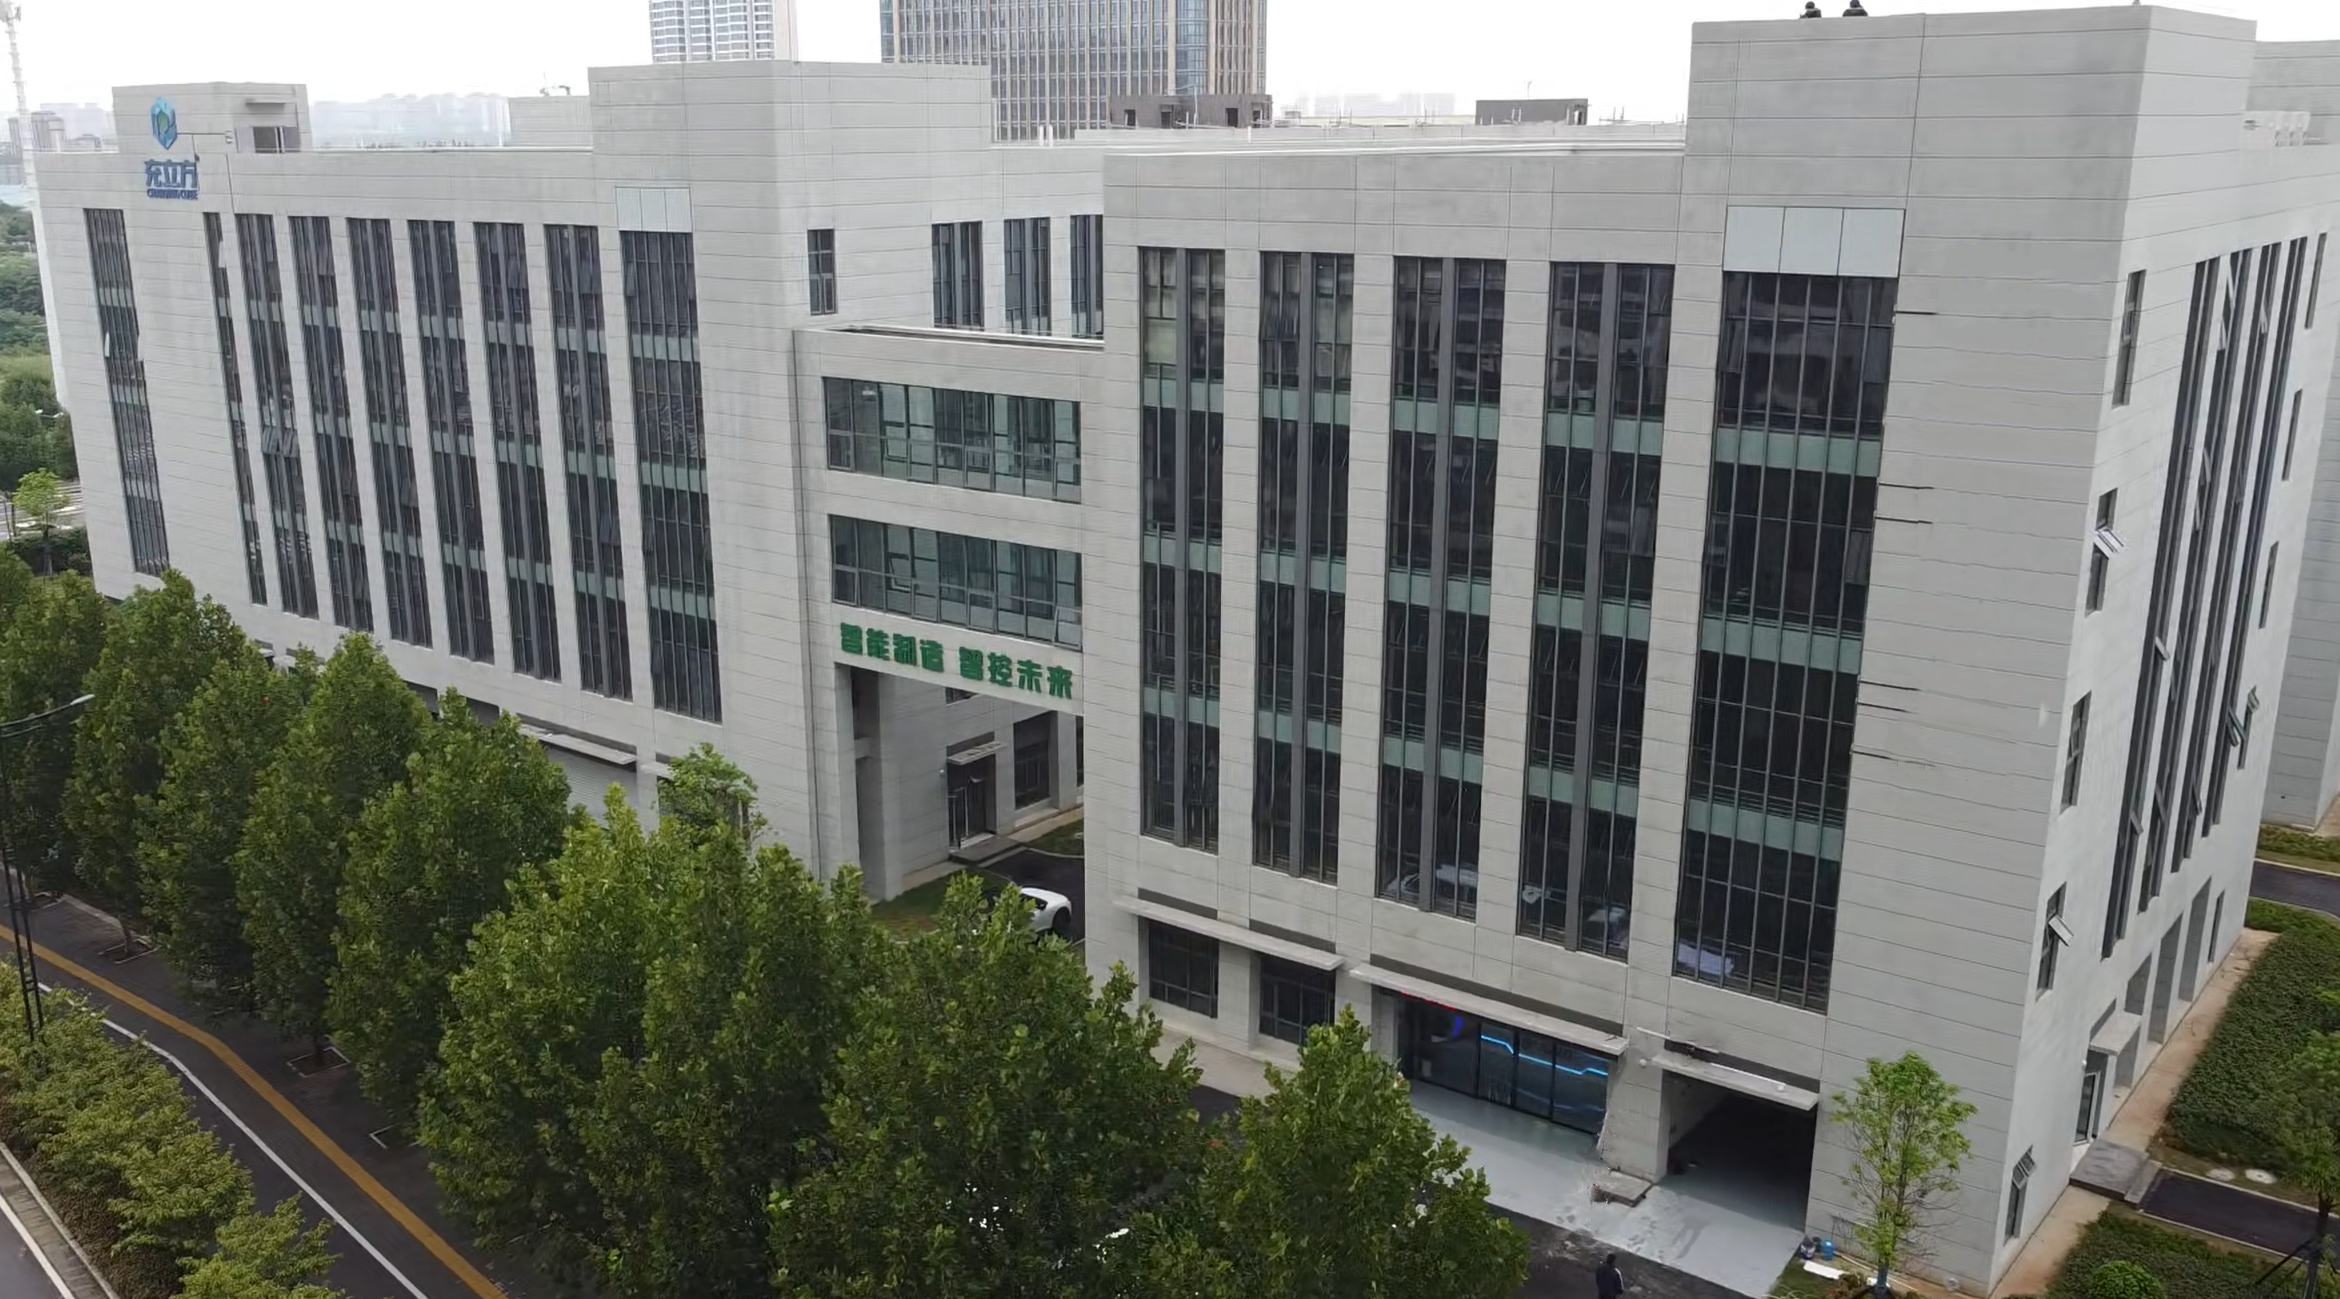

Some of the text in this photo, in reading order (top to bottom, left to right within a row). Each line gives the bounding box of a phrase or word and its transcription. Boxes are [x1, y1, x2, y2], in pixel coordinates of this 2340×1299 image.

[840, 622, 1073, 700] 智能制造 智控未来
